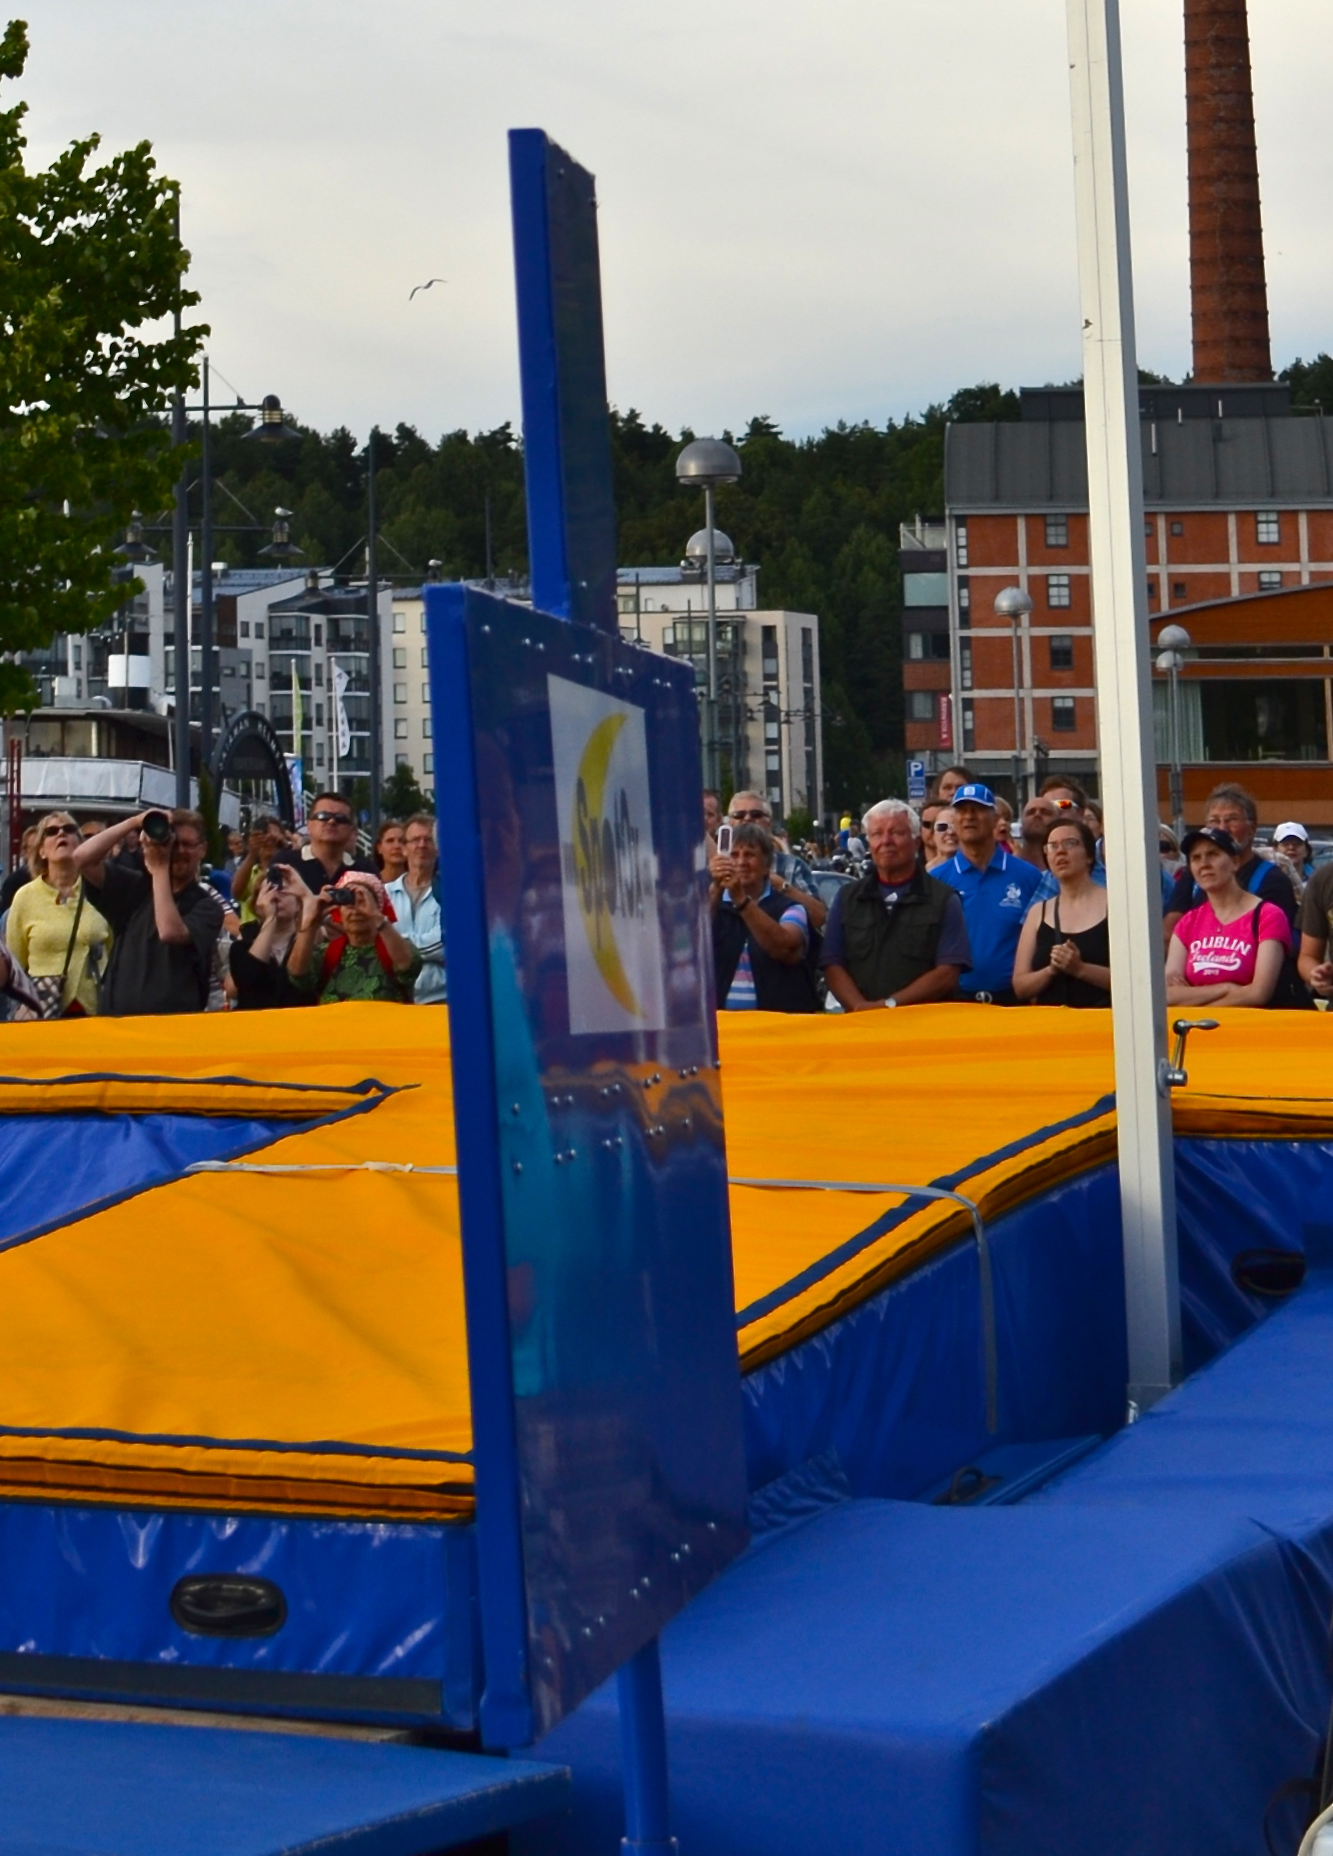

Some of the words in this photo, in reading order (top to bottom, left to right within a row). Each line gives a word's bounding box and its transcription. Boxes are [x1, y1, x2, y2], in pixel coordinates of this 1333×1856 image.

[910, 762, 922, 777] P
[1190, 936, 1251, 956] DUBLIN
[1189, 950, 1237, 964] Ireland
